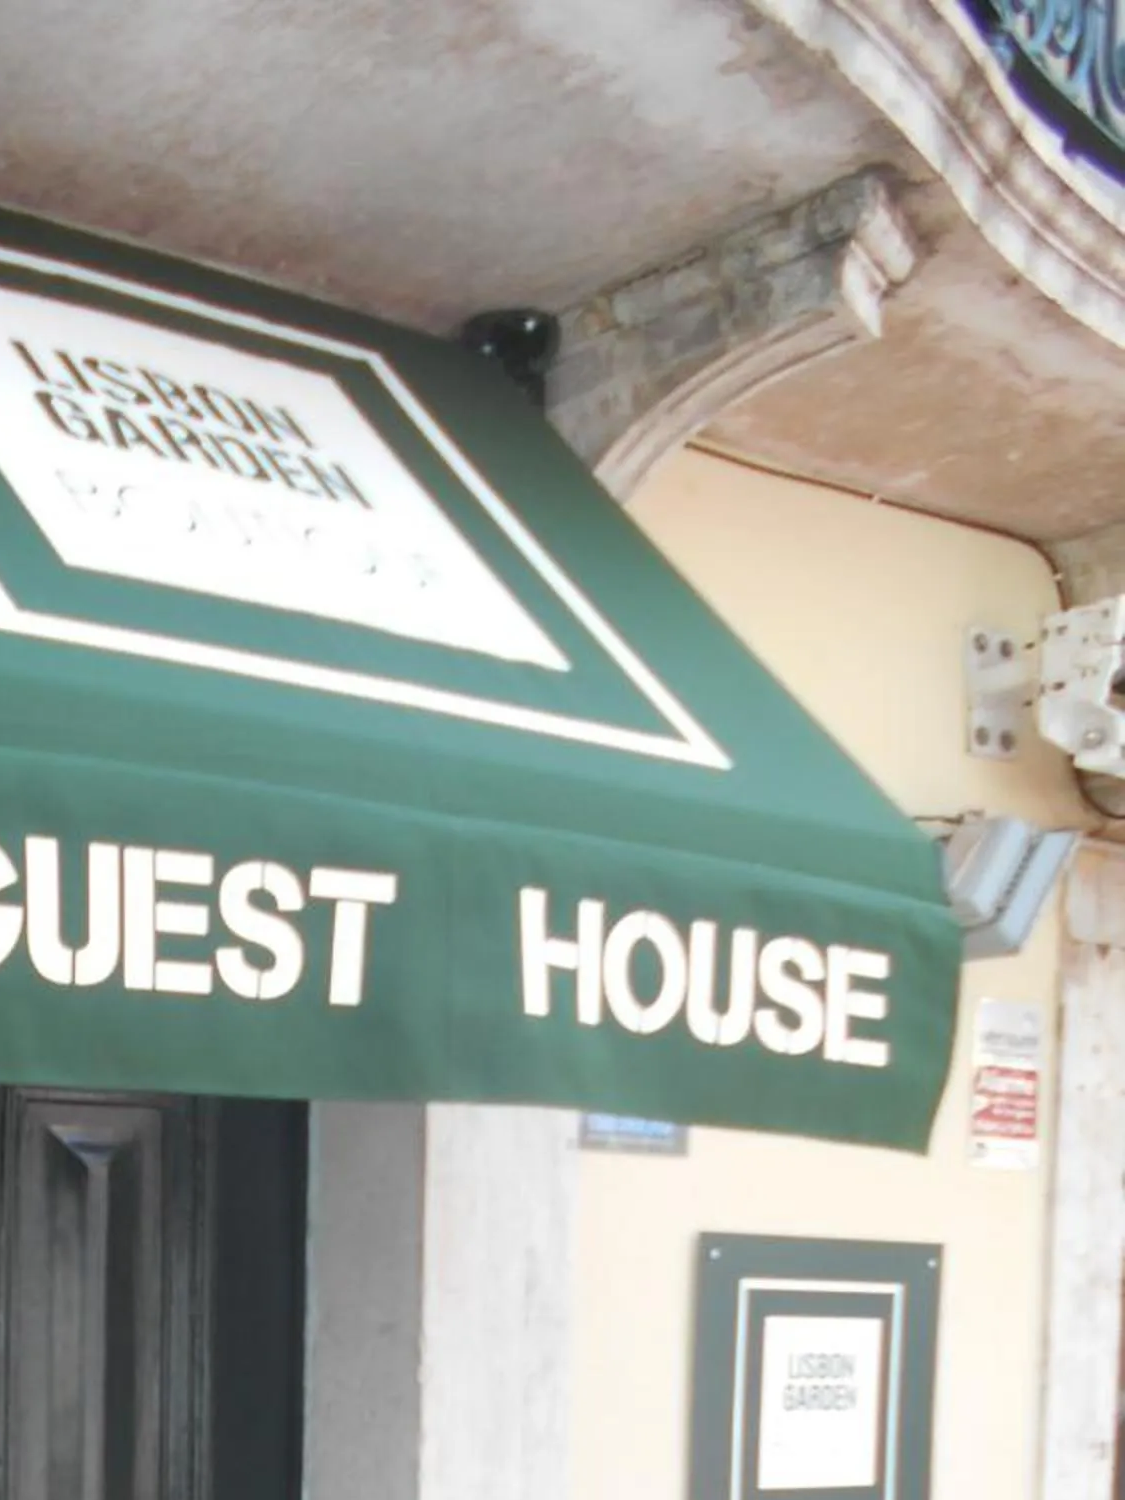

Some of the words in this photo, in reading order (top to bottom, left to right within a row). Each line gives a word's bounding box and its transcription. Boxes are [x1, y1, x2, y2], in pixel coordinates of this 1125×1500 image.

[8, 338, 315, 449] LISBON
[33, 388, 372, 511] GARDEN
[519, 885, 890, 1067] HOUSE
[782, 1384, 859, 1412] GARDEN
[787, 1353, 857, 1379] LISBON
